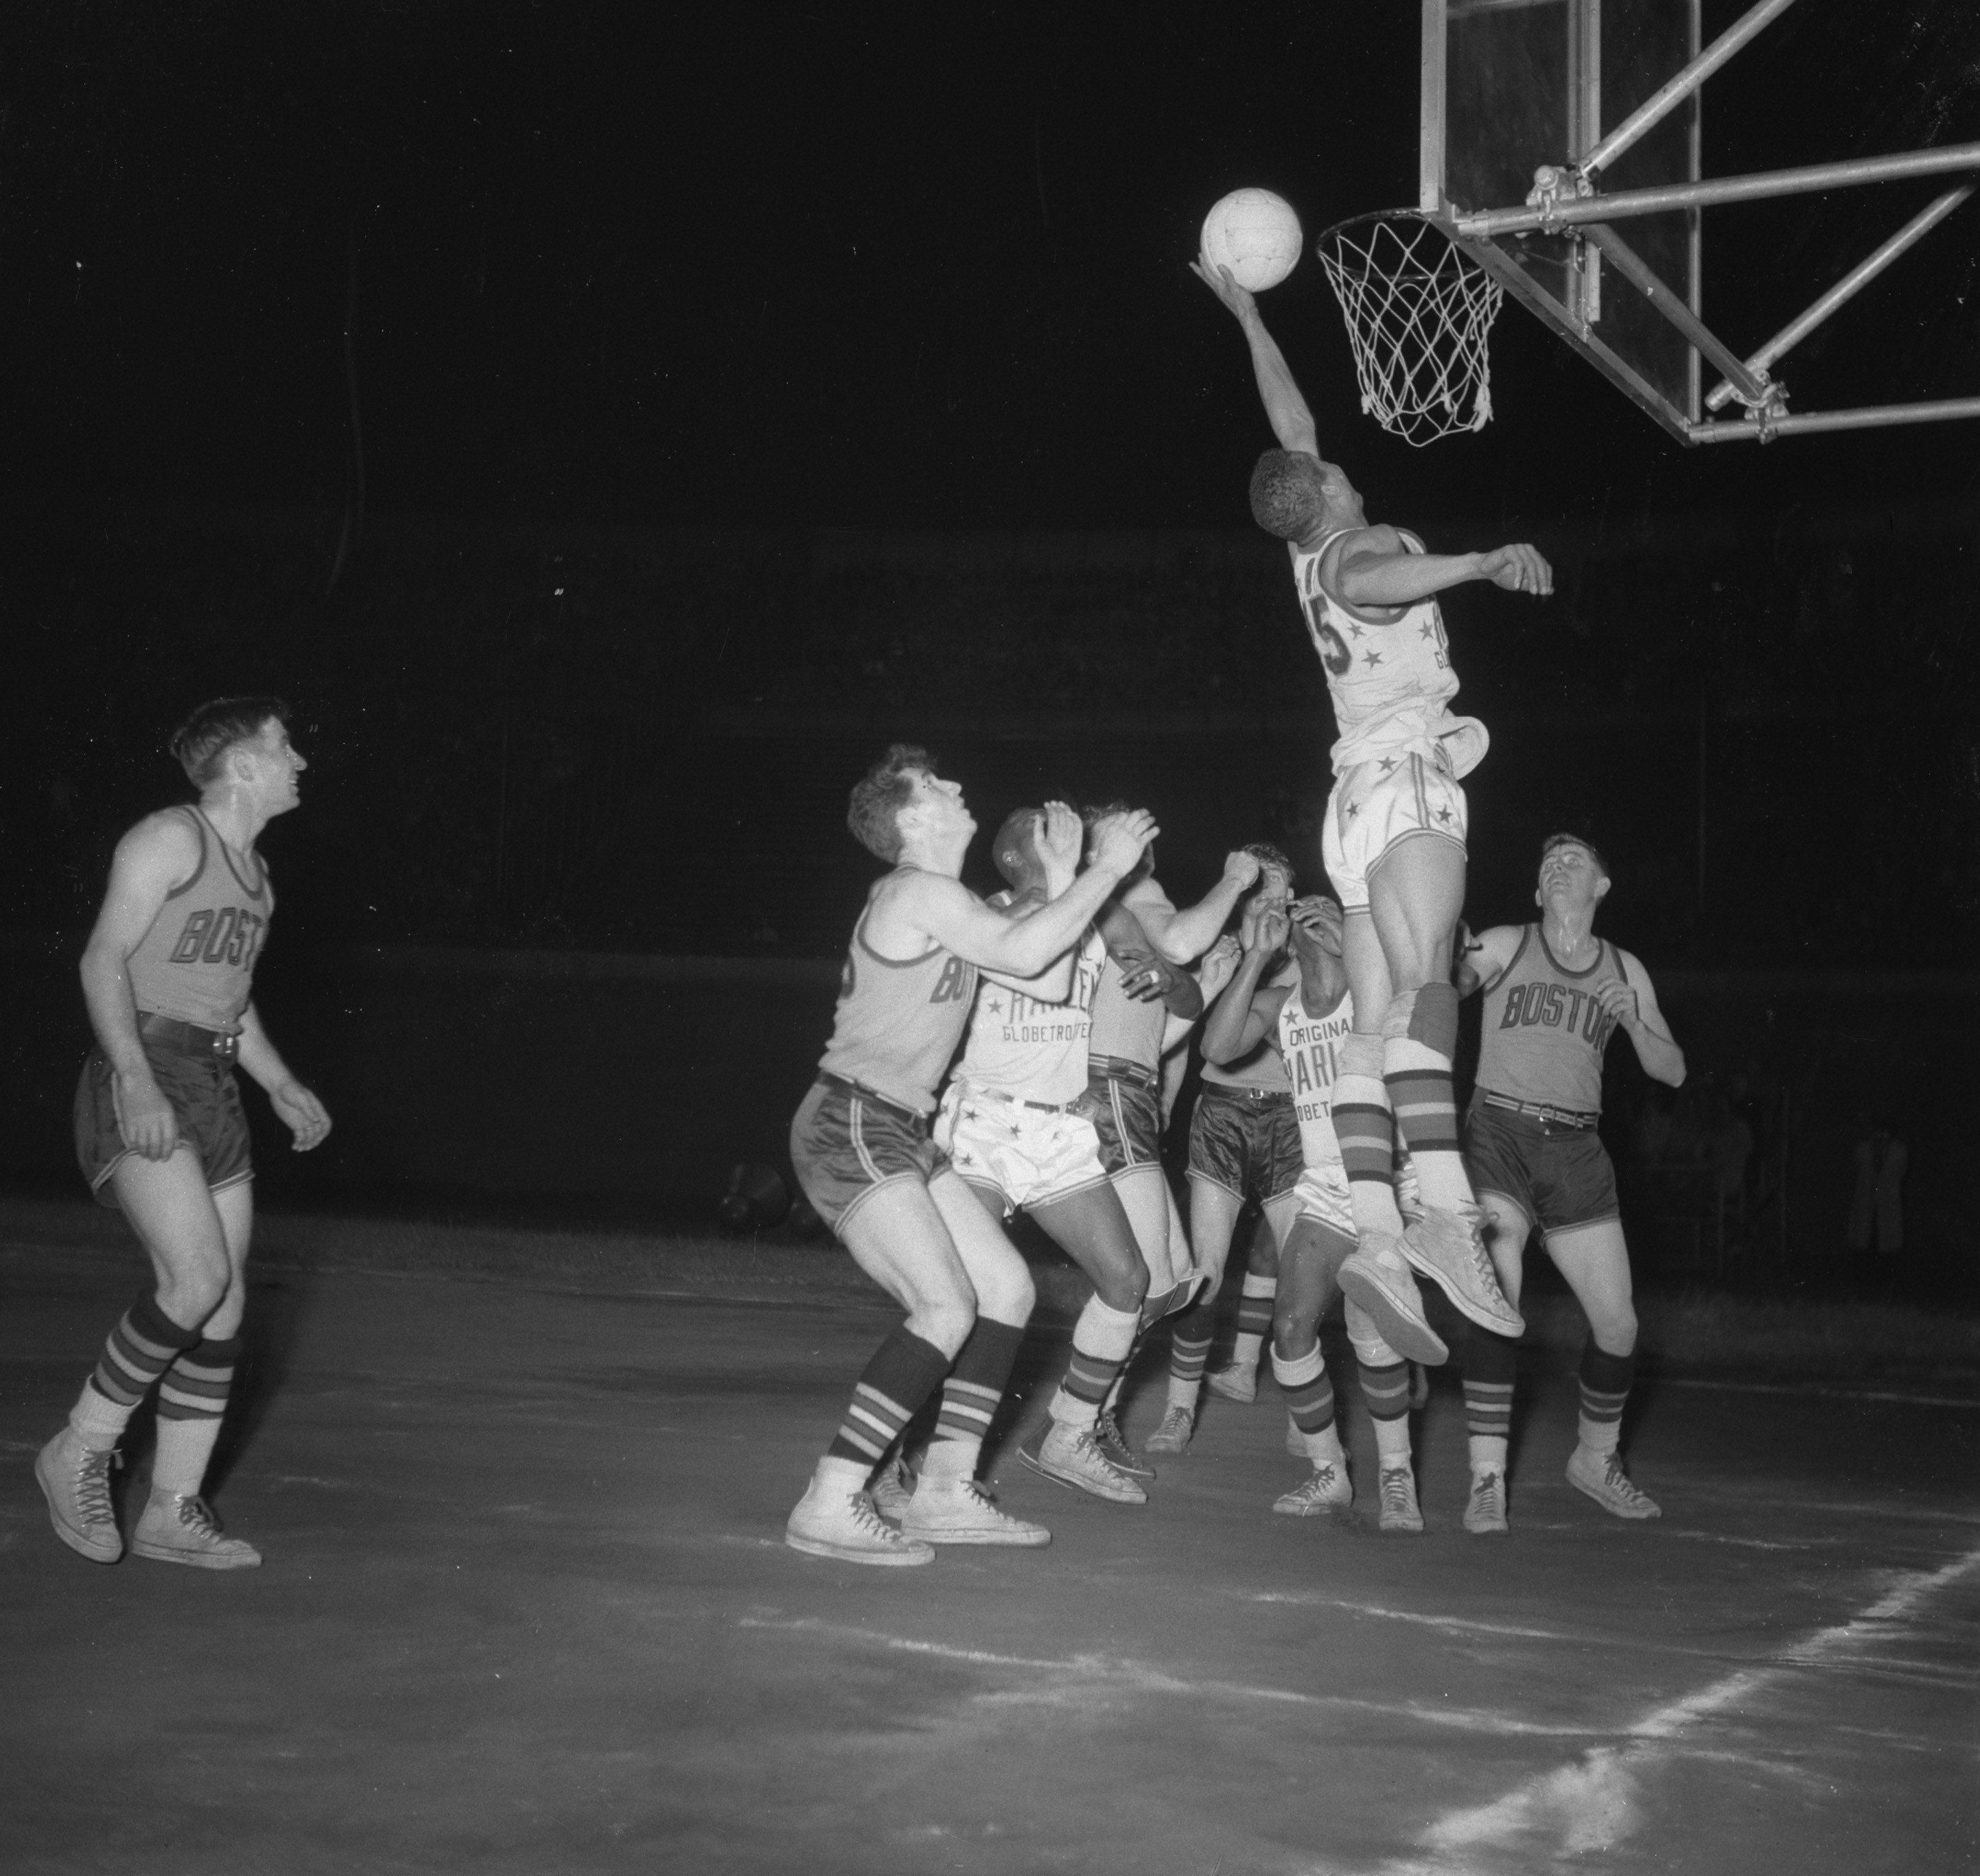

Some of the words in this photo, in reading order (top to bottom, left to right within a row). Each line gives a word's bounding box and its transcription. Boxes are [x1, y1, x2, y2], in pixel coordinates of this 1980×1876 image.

[169, 906, 263, 971] BOST
[1290, 1018, 1351, 1046] ORIGINA
[1296, 1101, 1330, 1122] OBET
